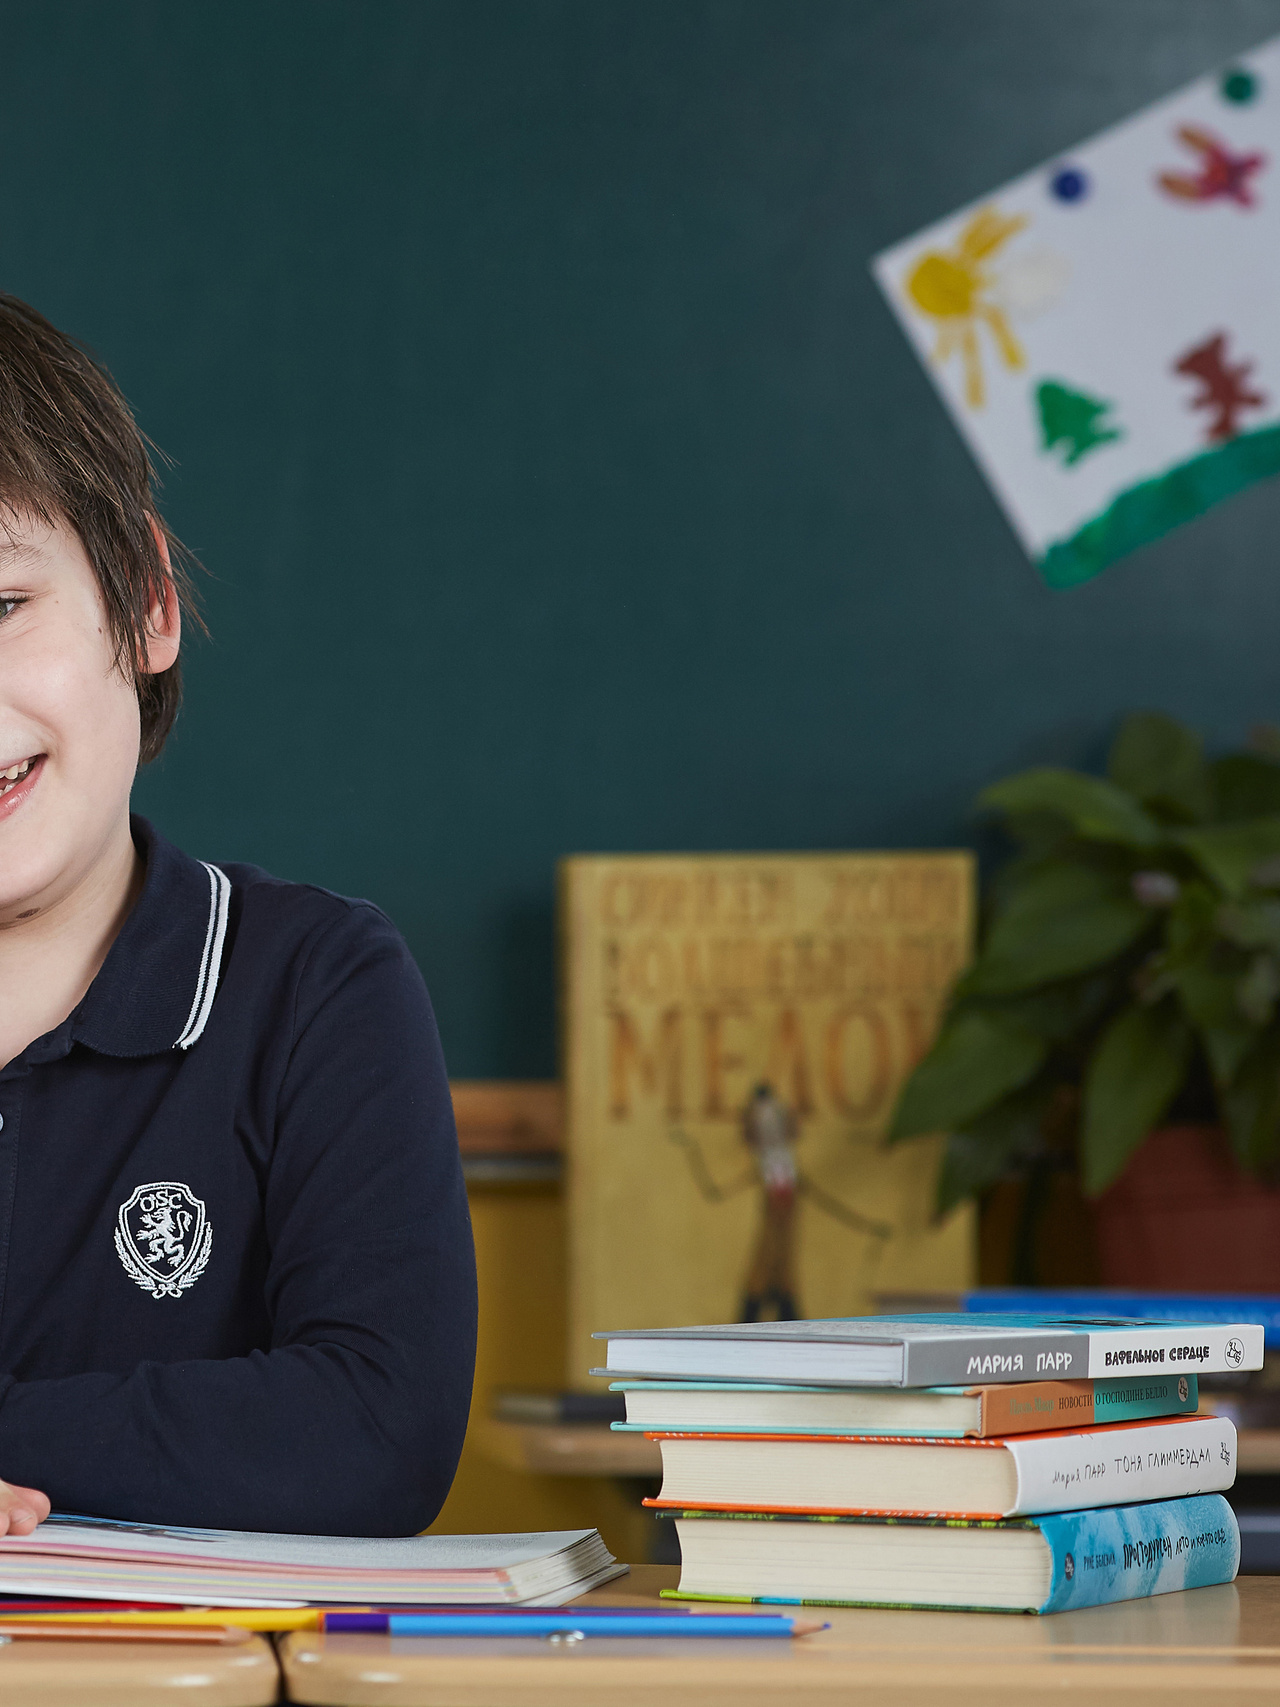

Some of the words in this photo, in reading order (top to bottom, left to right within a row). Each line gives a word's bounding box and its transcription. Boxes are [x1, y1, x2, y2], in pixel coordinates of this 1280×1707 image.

[139, 1189, 183, 1212] OSC
[967, 1354, 1024, 1375] МАРИЯ
[1036, 1352, 1073, 1372] ПАРР
[1105, 1349, 1165, 1366] ВАФЕЛЬНОЕ
[1169, 1346, 1210, 1363] СЕРДЦЕ
[1058, 1394, 1093, 1410] НОВОСТИ
[1102, 1388, 1145, 1405] ГОСПОДИНЕ
[1145, 1386, 1168, 1399] БЕЛЛО
[1084, 1463, 1106, 1480] ПАРР
[1114, 1455, 1143, 1474] ТОНЯ
[1148, 1448, 1211, 1469] ГЛИММЕРДАЛ
